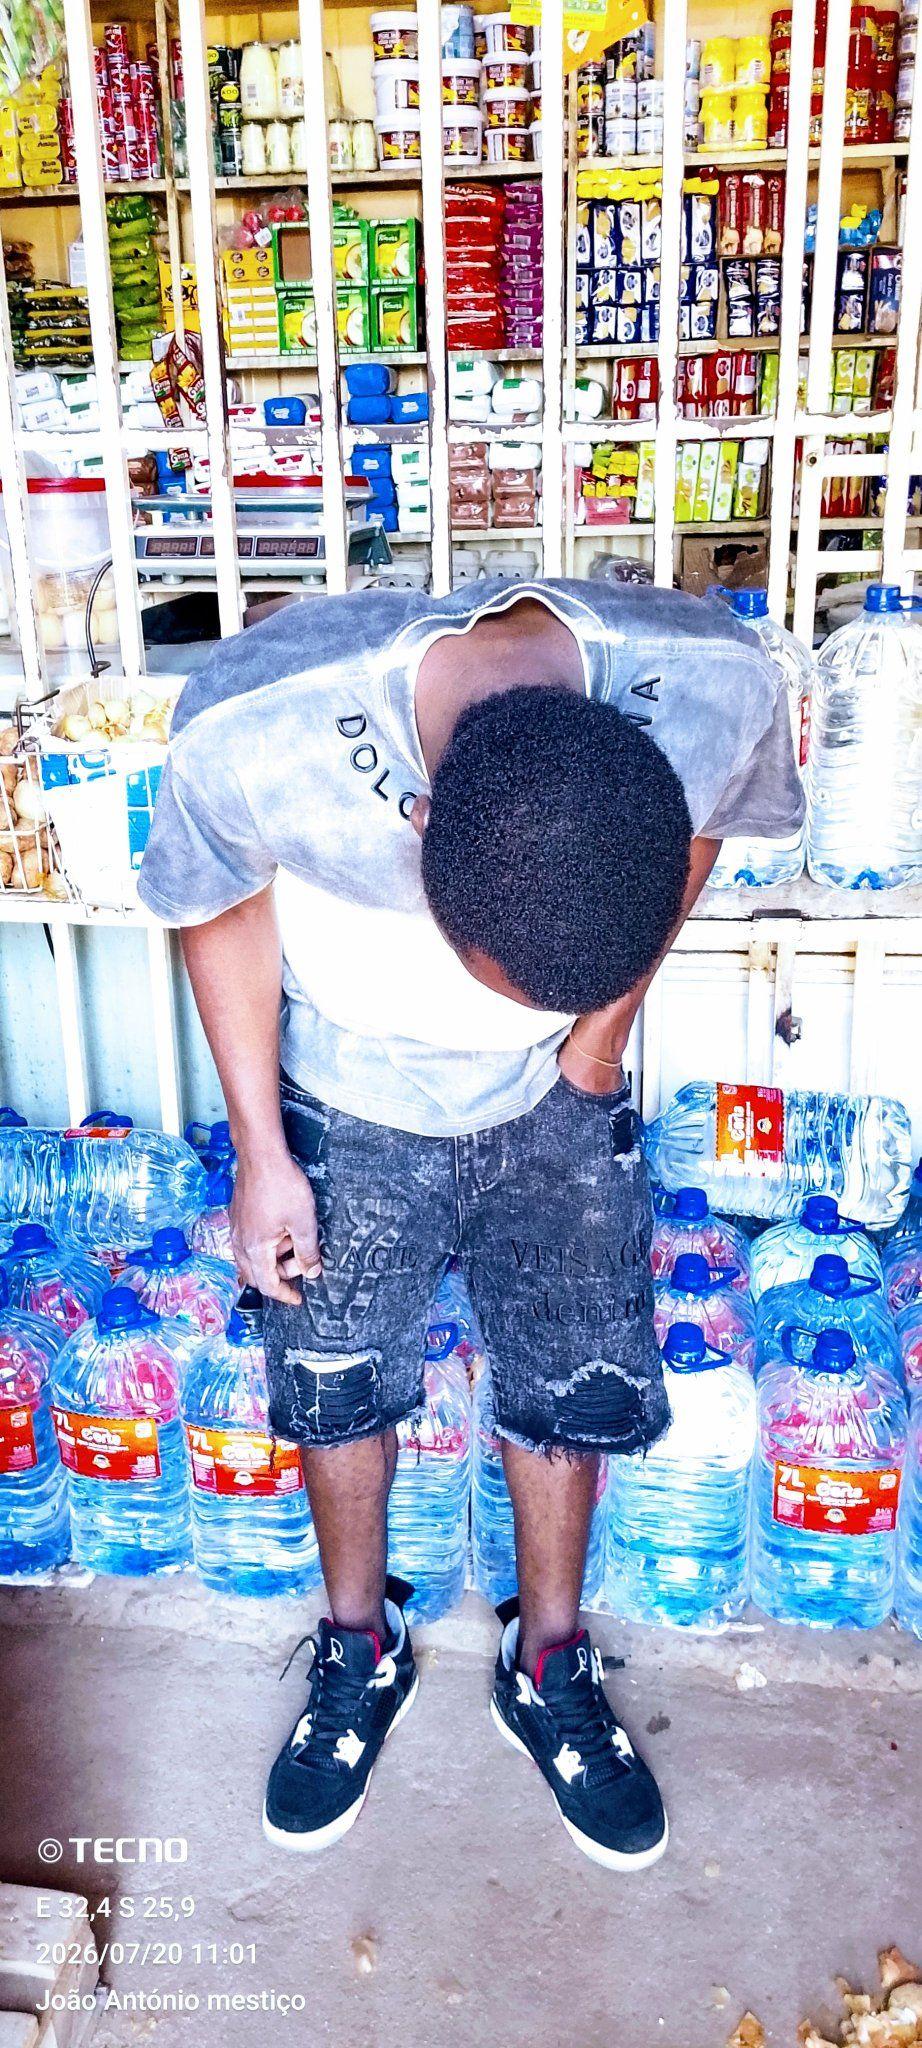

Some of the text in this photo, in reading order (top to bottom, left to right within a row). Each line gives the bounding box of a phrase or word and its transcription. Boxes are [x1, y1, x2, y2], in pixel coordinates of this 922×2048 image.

[335, 714, 418, 821] DOLC
[319, 1242, 419, 1272] SAGE
[52, 1410, 74, 1432] 7L
[189, 1430, 214, 1451] 7L
[778, 1465, 806, 1488] 7L
